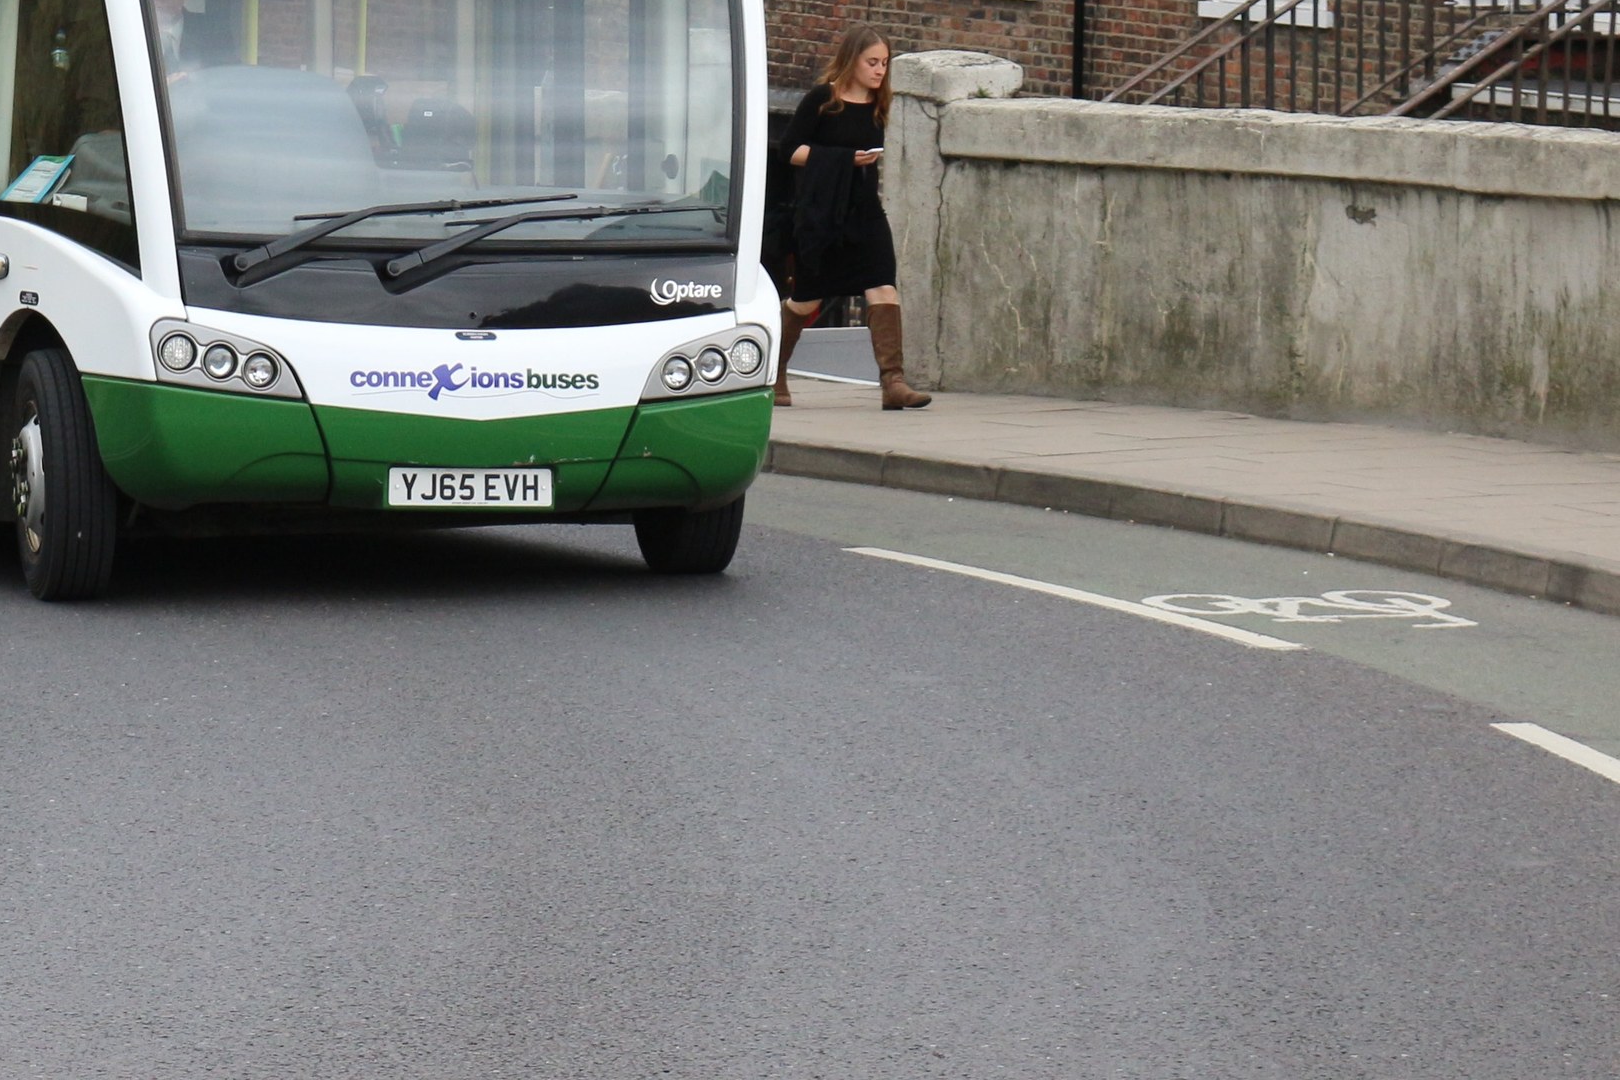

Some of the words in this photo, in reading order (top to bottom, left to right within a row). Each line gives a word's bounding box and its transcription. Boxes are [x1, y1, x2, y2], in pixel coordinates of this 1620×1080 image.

[662, 280, 723, 304] Optare
[401, 473, 475, 501] YJ65
[484, 473, 539, 501] EVH
